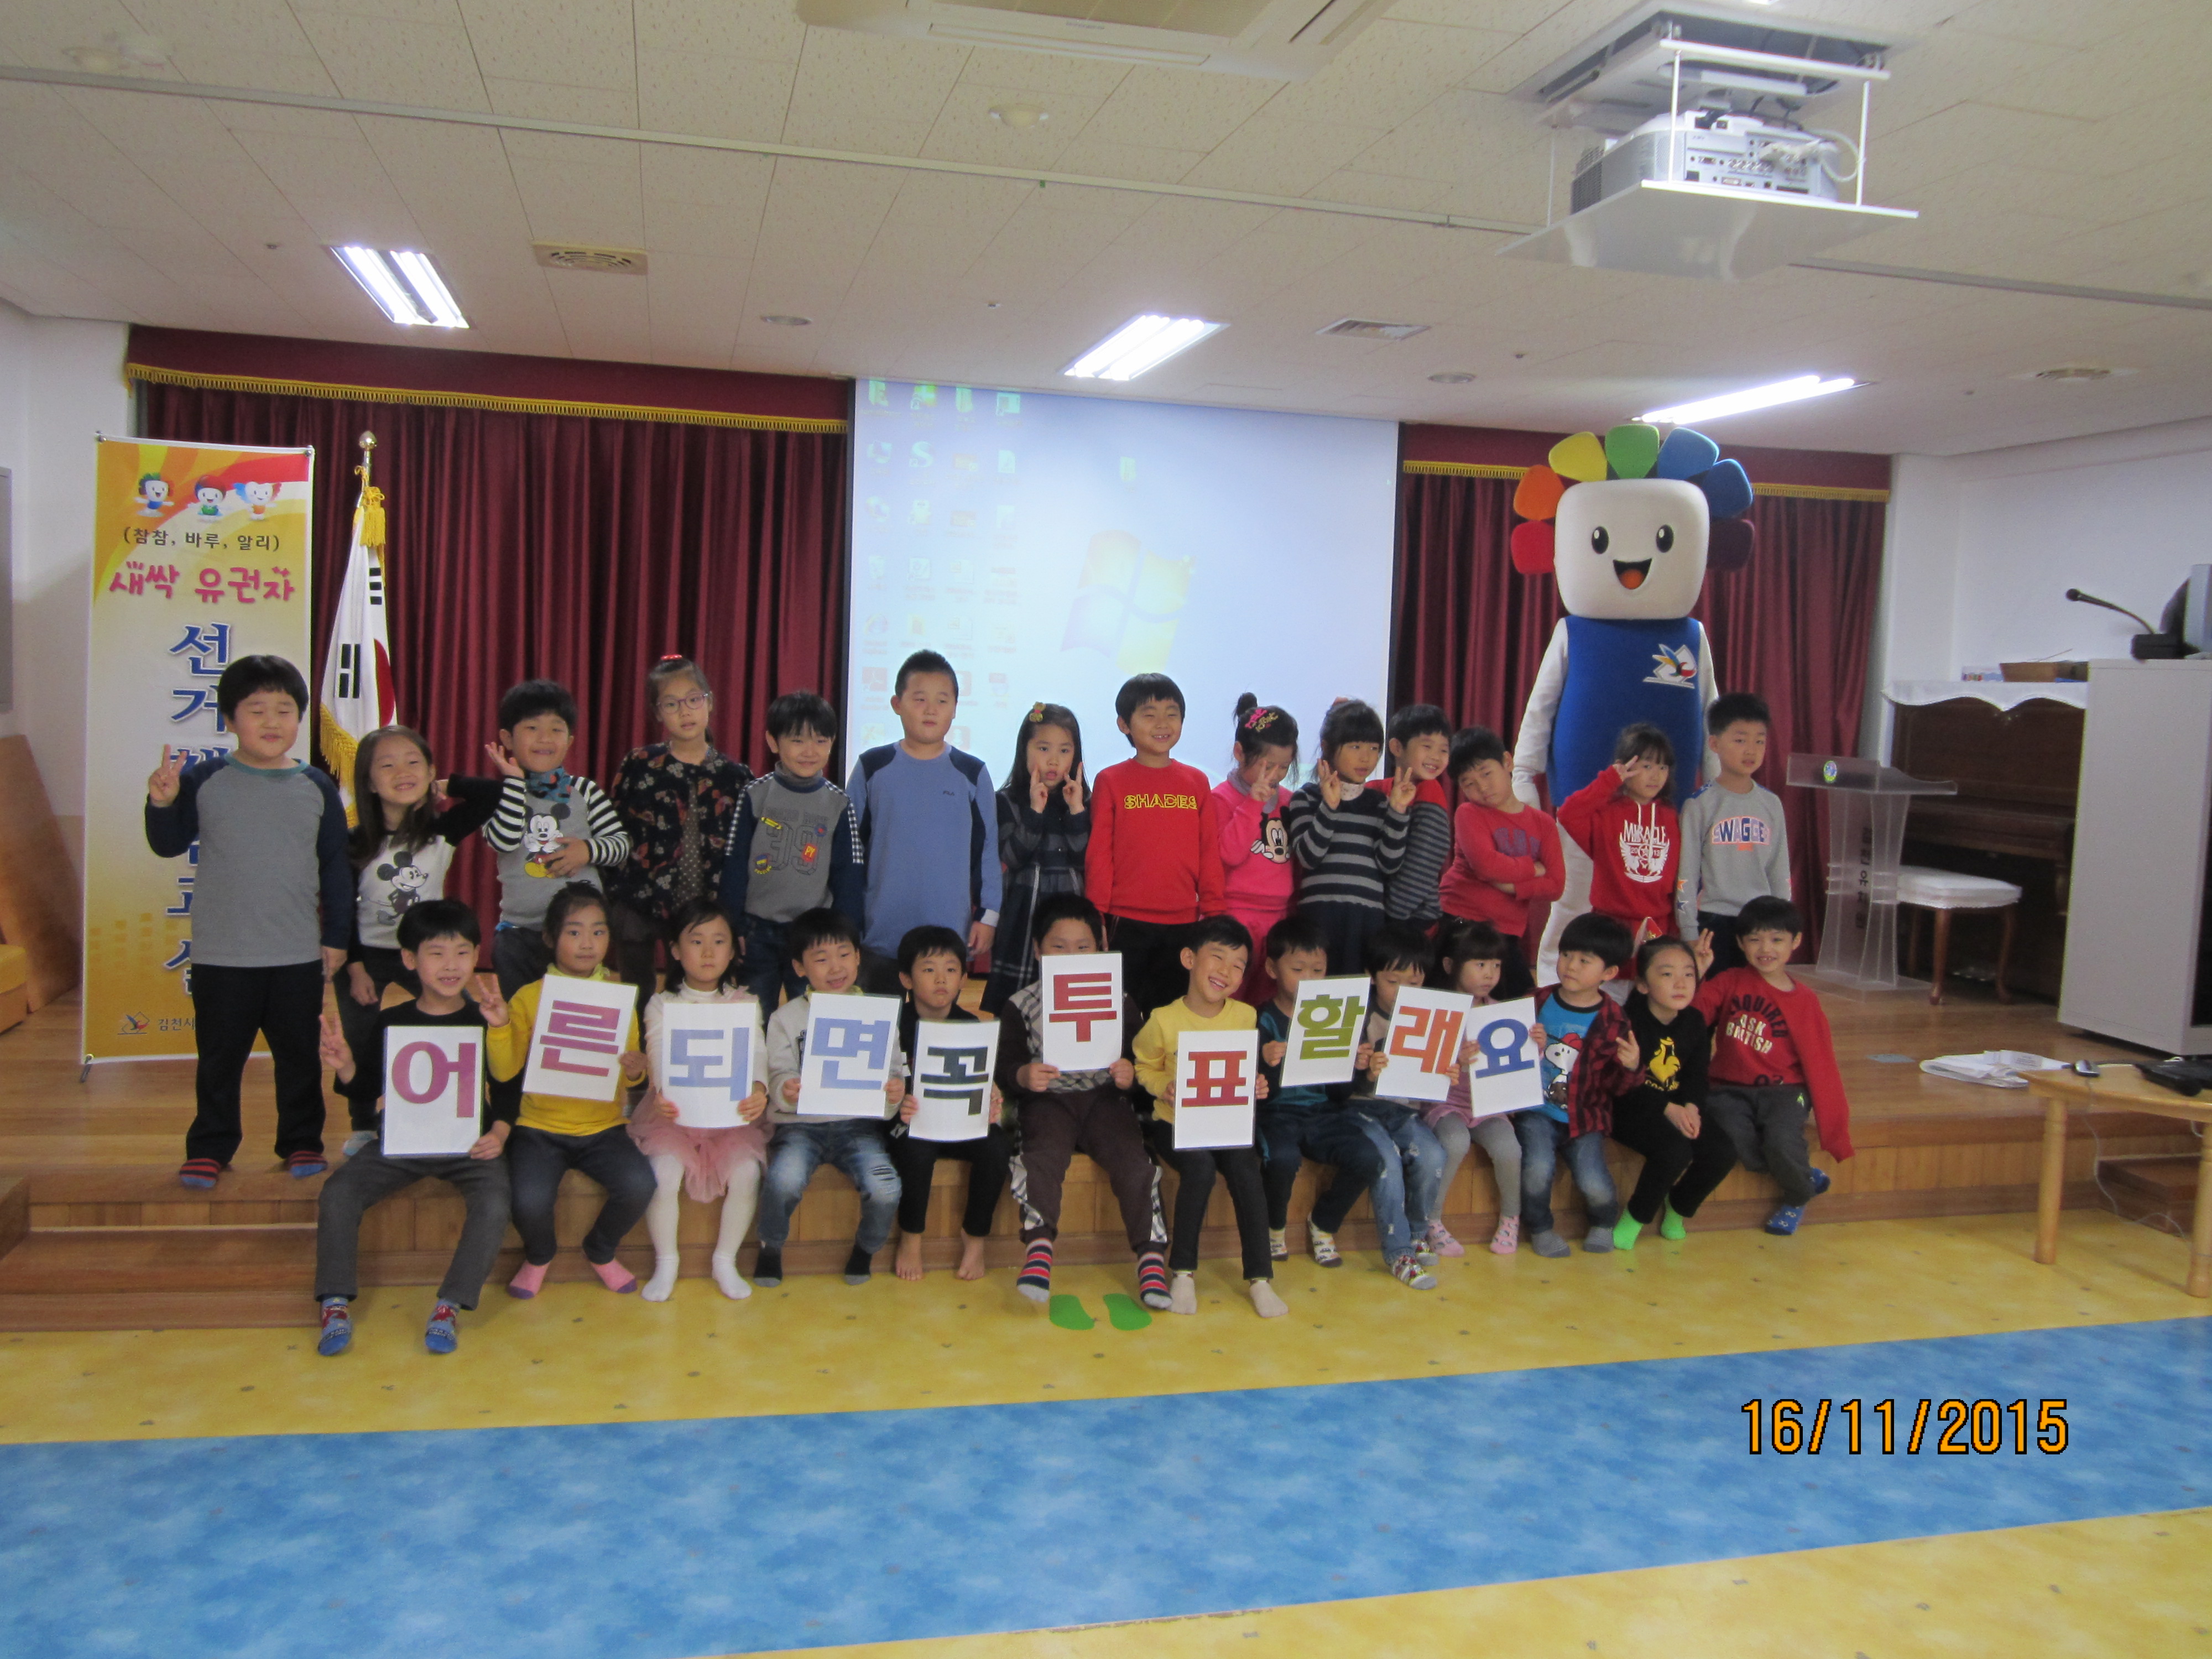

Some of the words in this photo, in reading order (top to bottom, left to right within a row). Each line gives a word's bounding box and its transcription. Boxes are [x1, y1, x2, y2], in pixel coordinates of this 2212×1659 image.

[123, 526, 176, 546] (참참,
[186, 532, 228, 549] 바루,
[238, 534, 280, 552] 알리)
[109, 561, 180, 599] 새싹
[195, 566, 295, 603] 유권자
[1124, 794, 1198, 810] SHADES
[540, 999, 620, 1077] 른
[1049, 972, 1118, 1042] 투
[1297, 994, 1366, 1061] 할
[1390, 1005, 1464, 1076] 래
[1740, 1014, 1767, 1037] ASK
[392, 1041, 476, 1119] 어
[669, 1026, 749, 1102] 되
[810, 1017, 891, 1091] 면
[920, 1045, 989, 1116] 꼭
[1181, 1050, 1249, 1108] 표
[1475, 1018, 1535, 1079] 요
